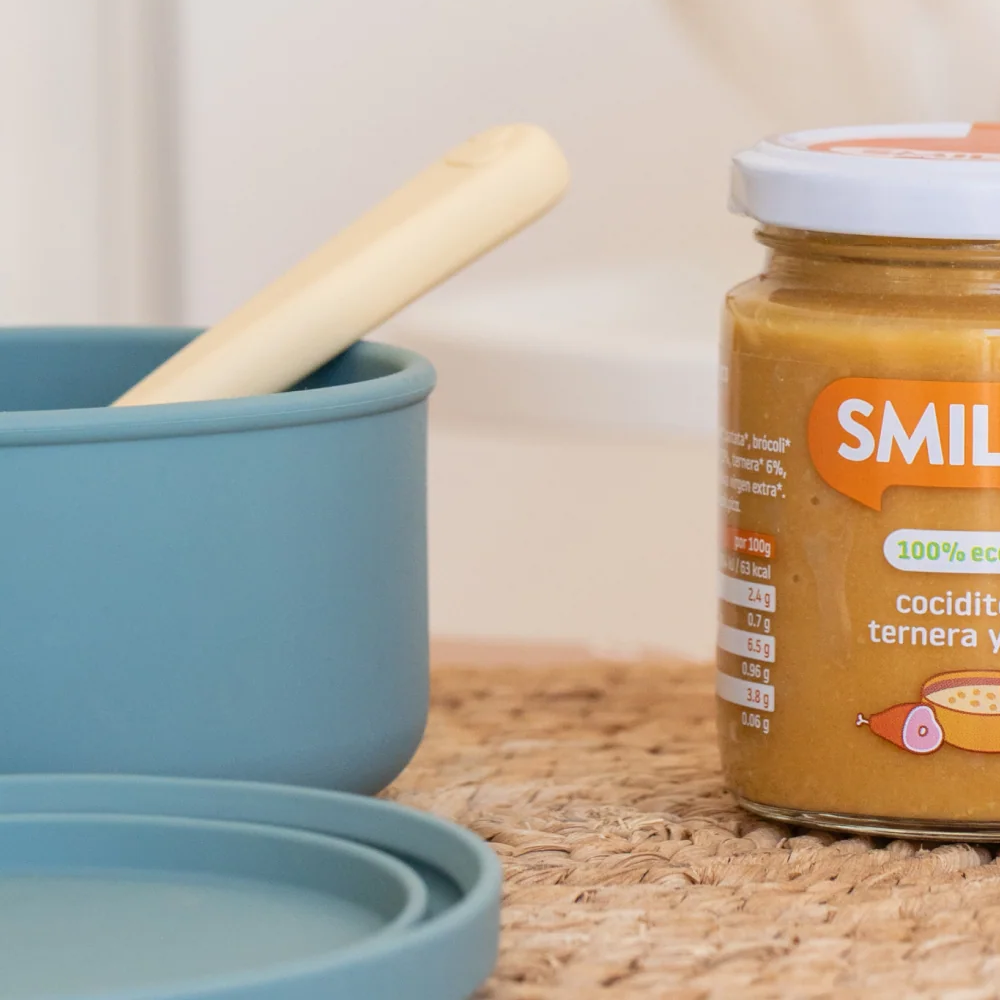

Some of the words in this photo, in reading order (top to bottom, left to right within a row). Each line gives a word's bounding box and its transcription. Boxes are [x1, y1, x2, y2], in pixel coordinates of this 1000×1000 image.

[897, 540, 965, 562] 100%
[752, 562, 771, 580] kcal
[764, 593, 770, 608] g
[763, 618, 770, 633] g
[868, 620, 977, 648] ternera
[764, 644, 770, 658] g
[763, 668, 770, 683] g
[763, 694, 769, 708] g
[763, 719, 770, 734] g
